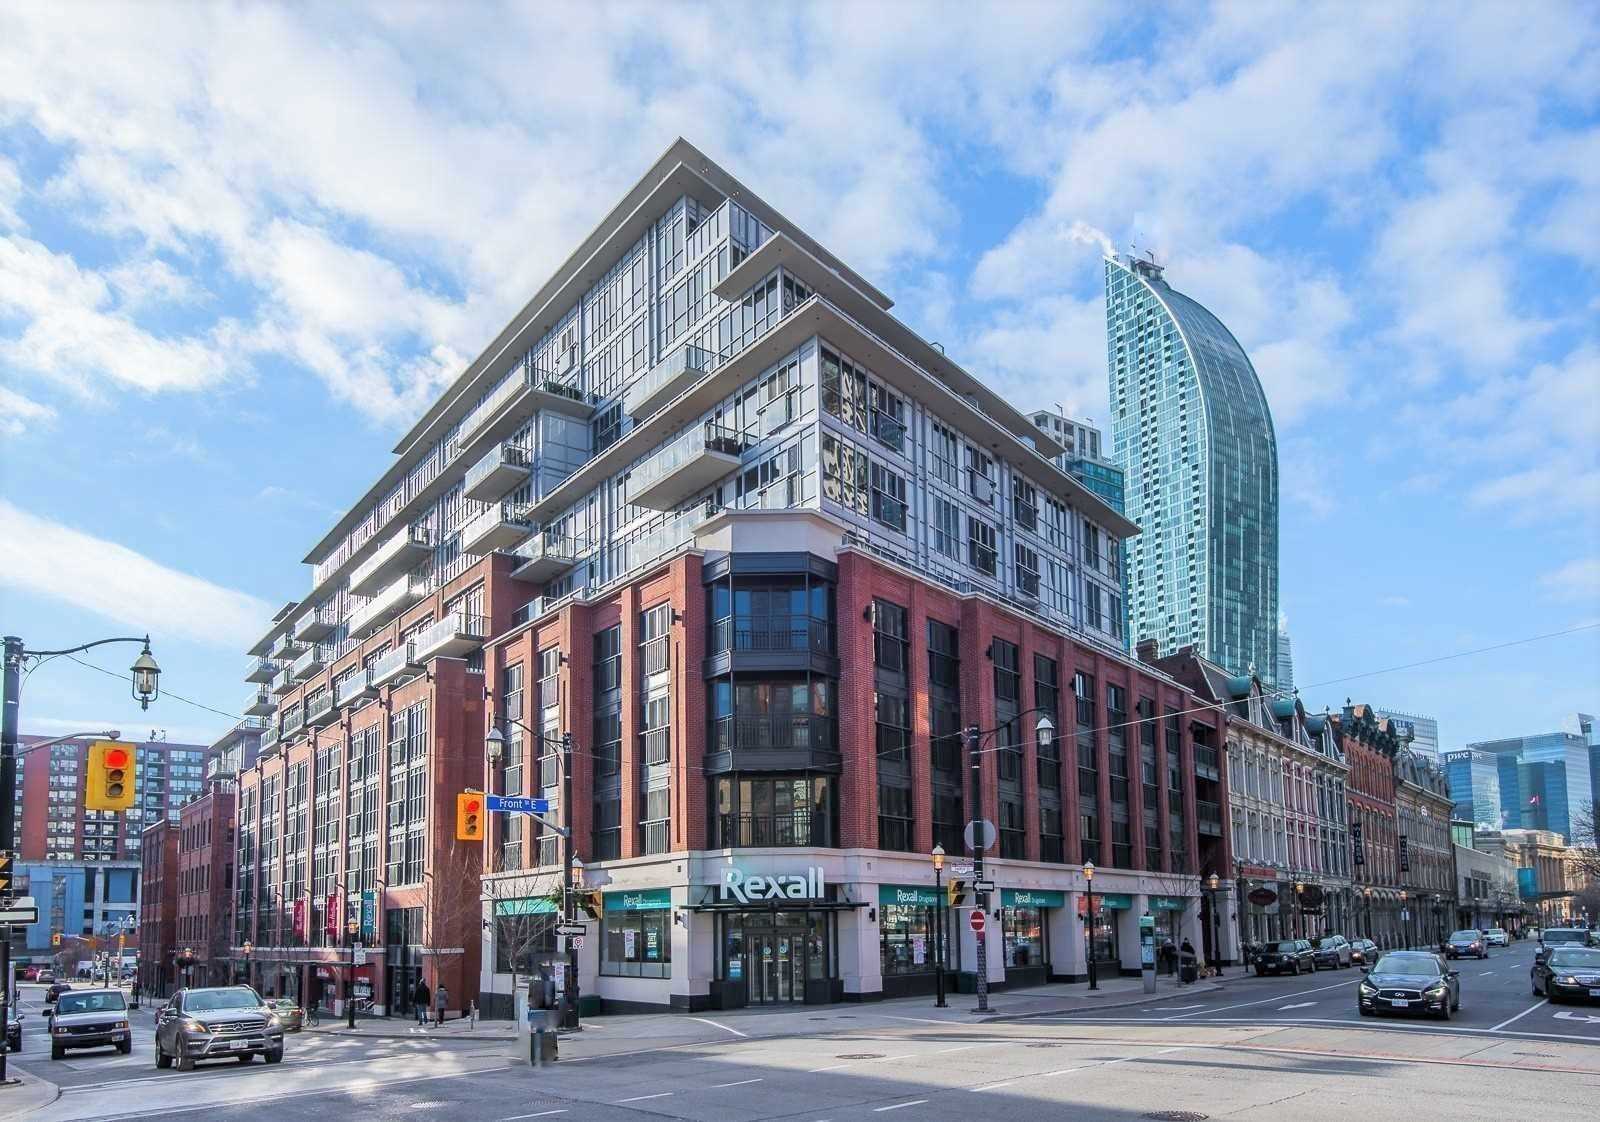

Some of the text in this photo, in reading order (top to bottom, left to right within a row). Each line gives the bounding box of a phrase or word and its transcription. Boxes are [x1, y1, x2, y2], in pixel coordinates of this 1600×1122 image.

[499, 798, 523, 809] Front
[531, 800, 537, 809] E
[720, 867, 825, 904] Rexall
[623, 894, 642, 907] Rexall
[897, 889, 918, 903] Rexall
[364, 899, 374, 927] Rexall
